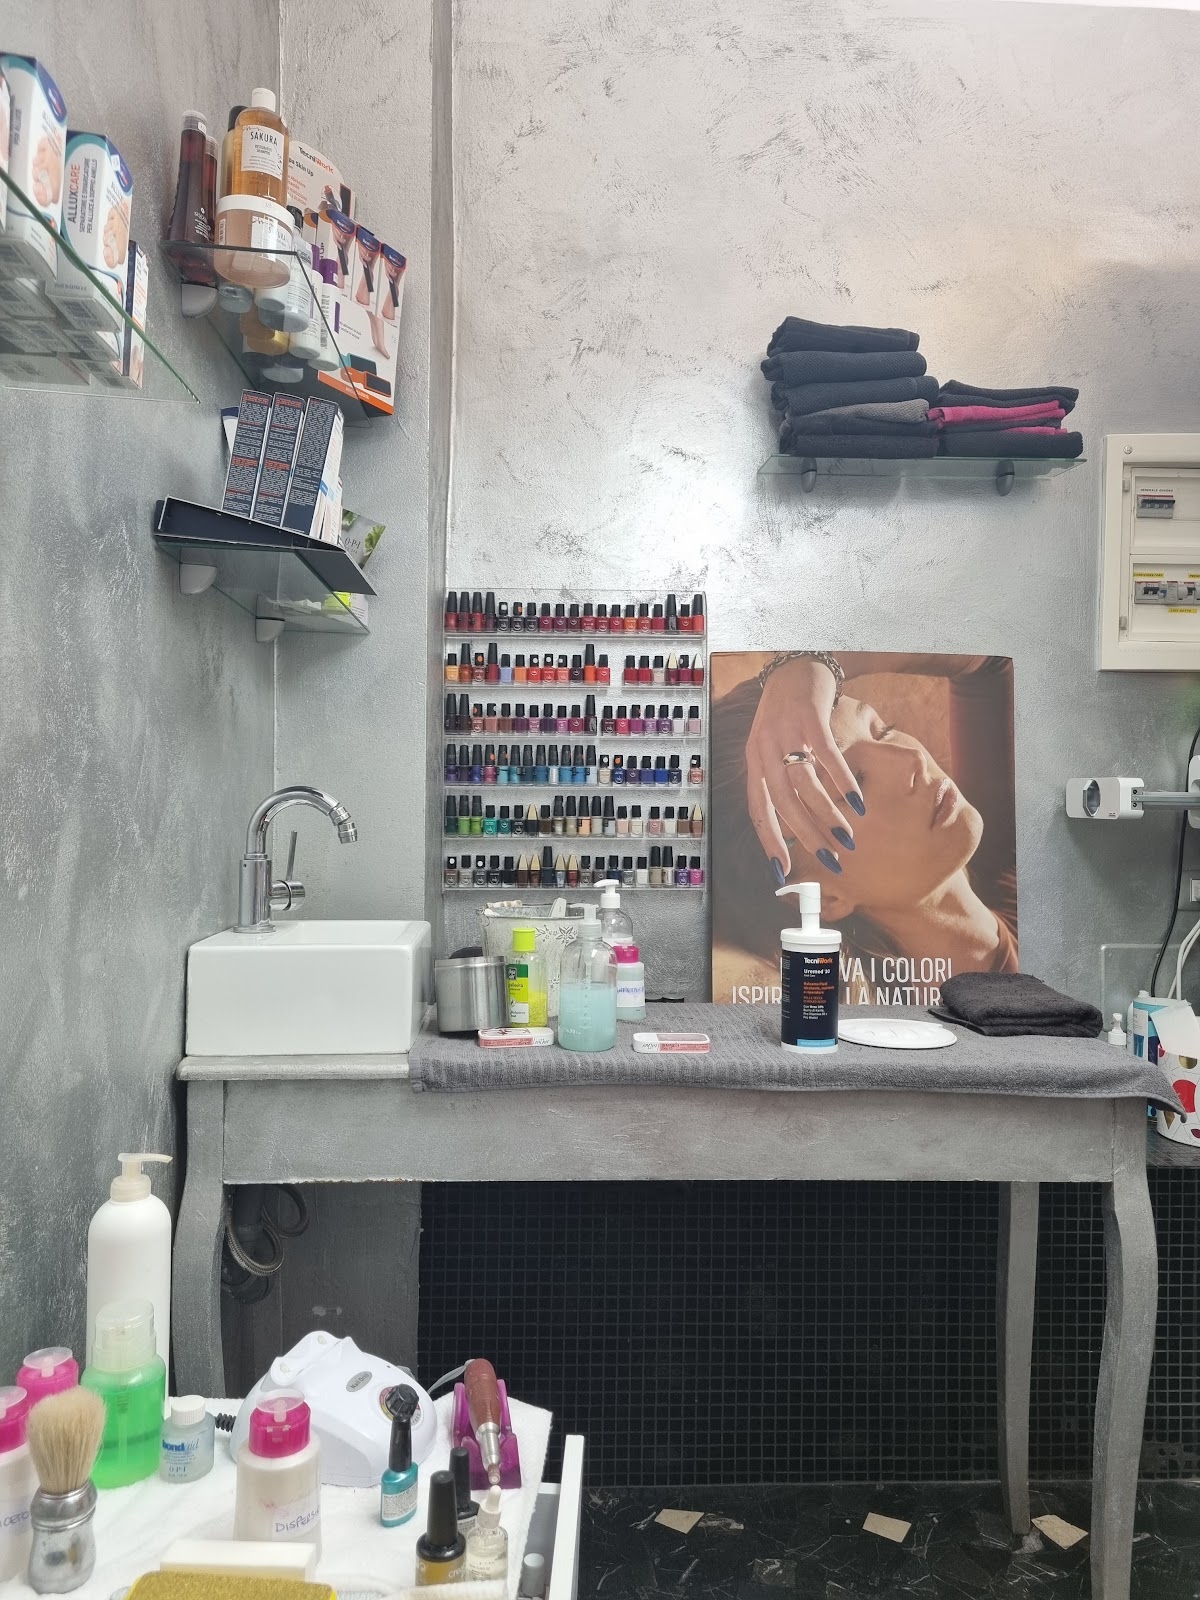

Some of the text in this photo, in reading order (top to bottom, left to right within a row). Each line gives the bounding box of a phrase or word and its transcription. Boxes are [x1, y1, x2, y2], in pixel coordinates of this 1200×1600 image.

[250, 132, 277, 146] SAKURA
[296, 161, 306, 172] Skin
[298, 146, 334, 174] TecniWork
[68, 164, 81, 224] ALLUXCARE
[871, 958, 875, 982] I
[882, 957, 952, 983] COLORI
[732, 985, 782, 1004] ISPIR
[877, 986, 941, 1005] NATUR
[350, 1380, 361, 1389] Nail
[162, 1438, 199, 1451] bondaid
[0, 1510, 31, 1527] CETO
